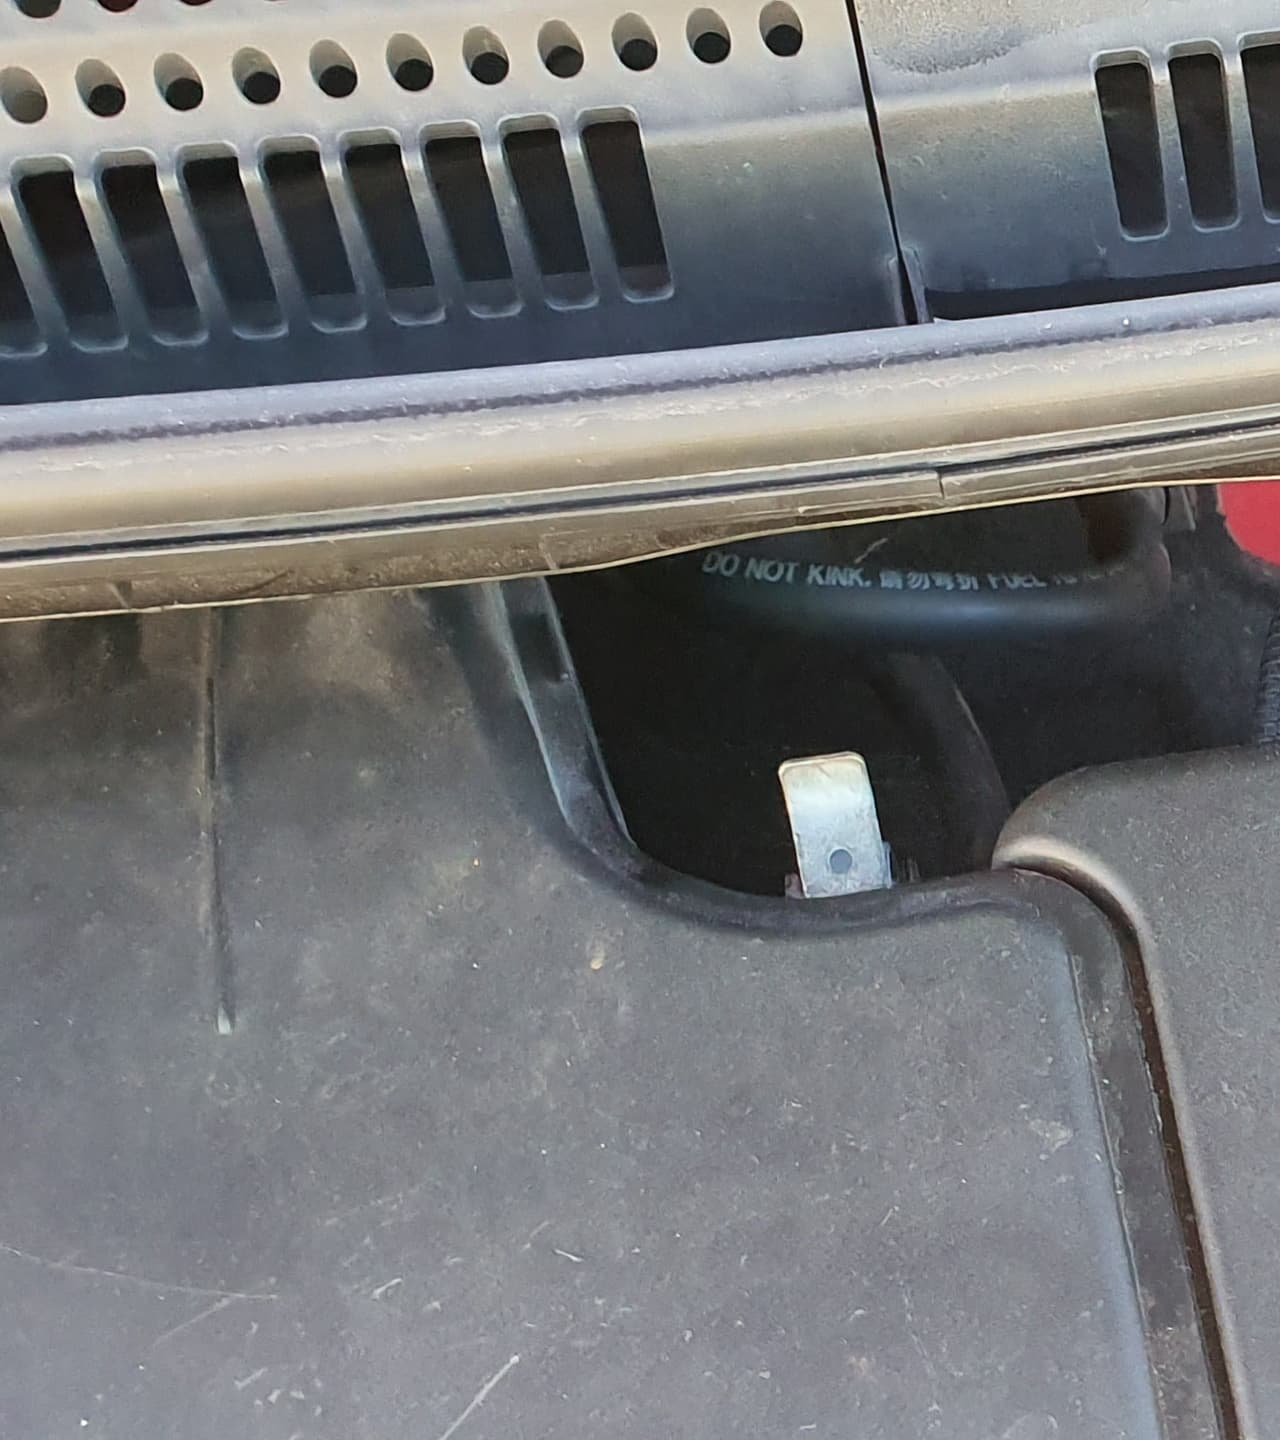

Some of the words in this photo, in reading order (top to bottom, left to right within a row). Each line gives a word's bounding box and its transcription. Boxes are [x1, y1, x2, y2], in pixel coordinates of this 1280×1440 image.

[702, 550, 739, 577] DO
[745, 558, 799, 582] NOT
[807, 564, 871, 587] KINK.
